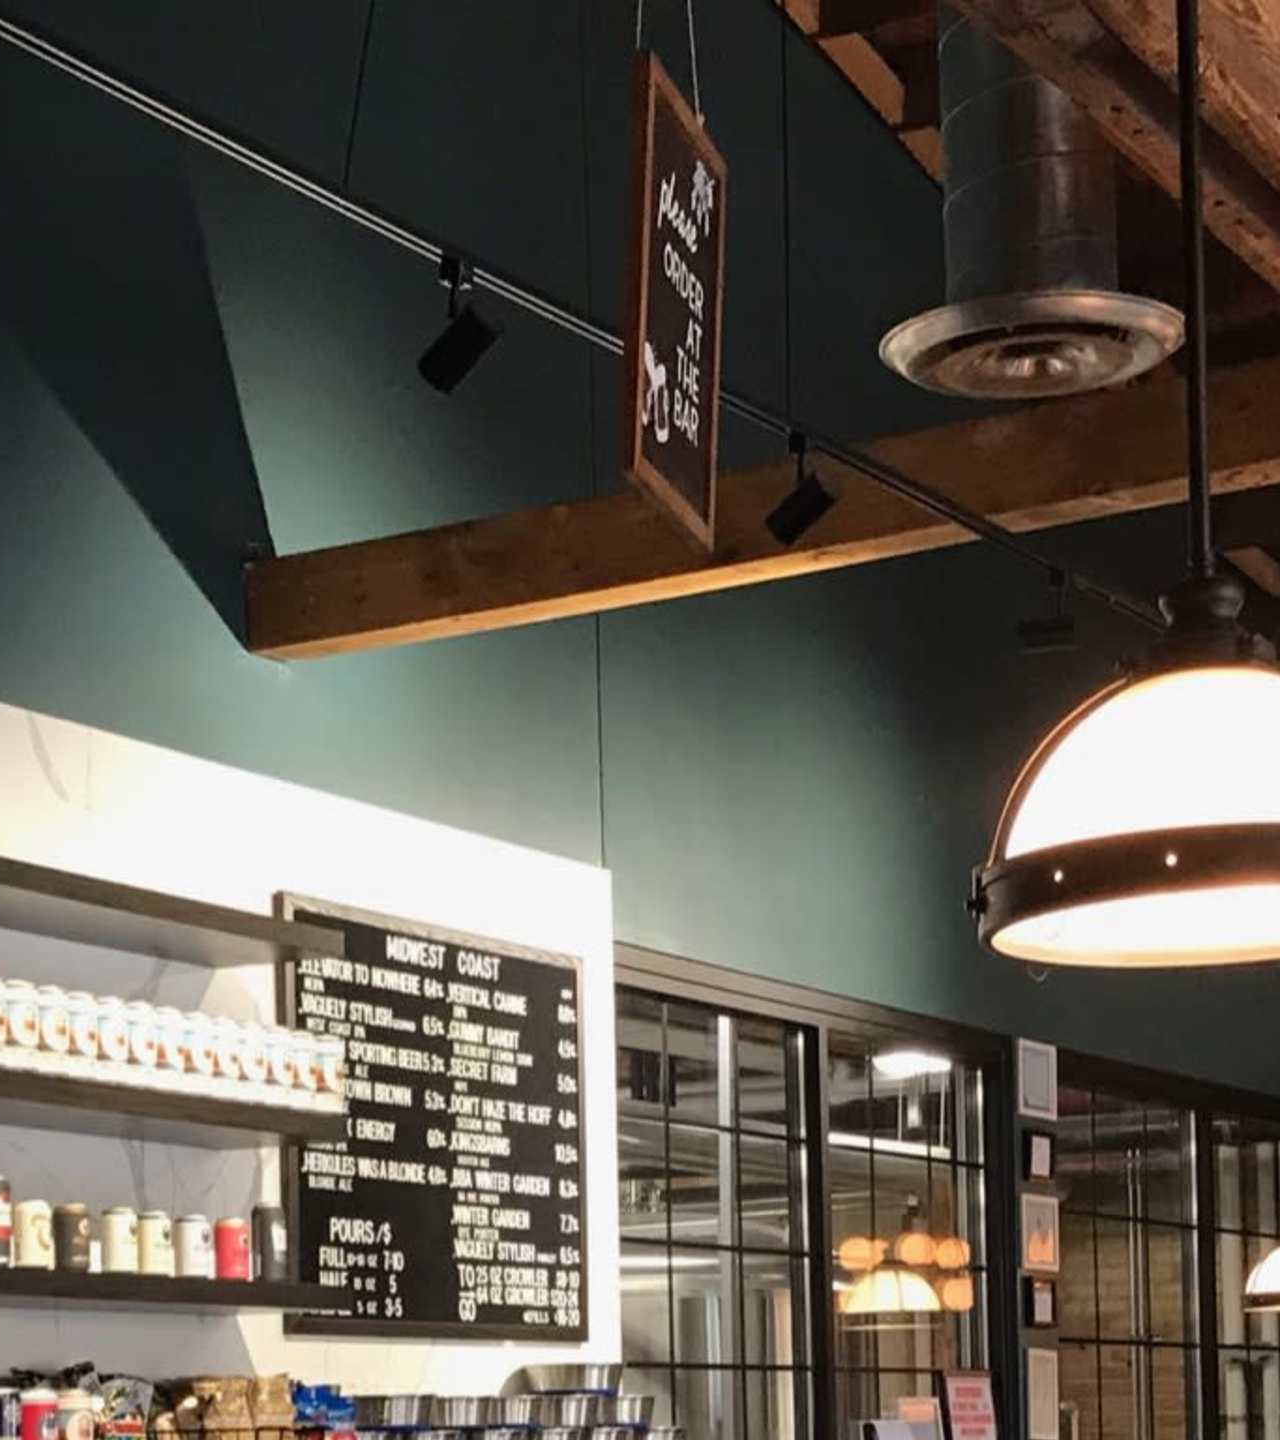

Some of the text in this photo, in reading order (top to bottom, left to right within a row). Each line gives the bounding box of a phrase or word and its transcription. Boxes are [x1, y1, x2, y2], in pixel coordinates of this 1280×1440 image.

[657, 172, 697, 253] please
[664, 241, 704, 321] ORDER
[685, 318, 702, 361] AT
[676, 343, 699, 404] THE
[674, 388, 699, 447] BAR
[385, 934, 501, 982] MIDWEST COAST
[355, 963, 369, 985] TO
[371, 966, 421, 996] NOWHERE
[508, 1101, 526, 1123] THE
[527, 1104, 552, 1125] HOFF
[356, 1117, 396, 1143] ENERGY
[512, 1173, 551, 1197] GARDEN
[329, 1216, 375, 1245] POURS
[491, 1208, 531, 1230] GARDEN
[319, 1245, 348, 1269] FULL
[389, 1273, 398, 1294] 5
[457, 1263, 476, 1288] TO
[489, 1265, 503, 1286] OZ
[385, 1297, 403, 1318] 3-5
[490, 1286, 503, 1305] OZ
[458, 1298, 477, 1322] GO
